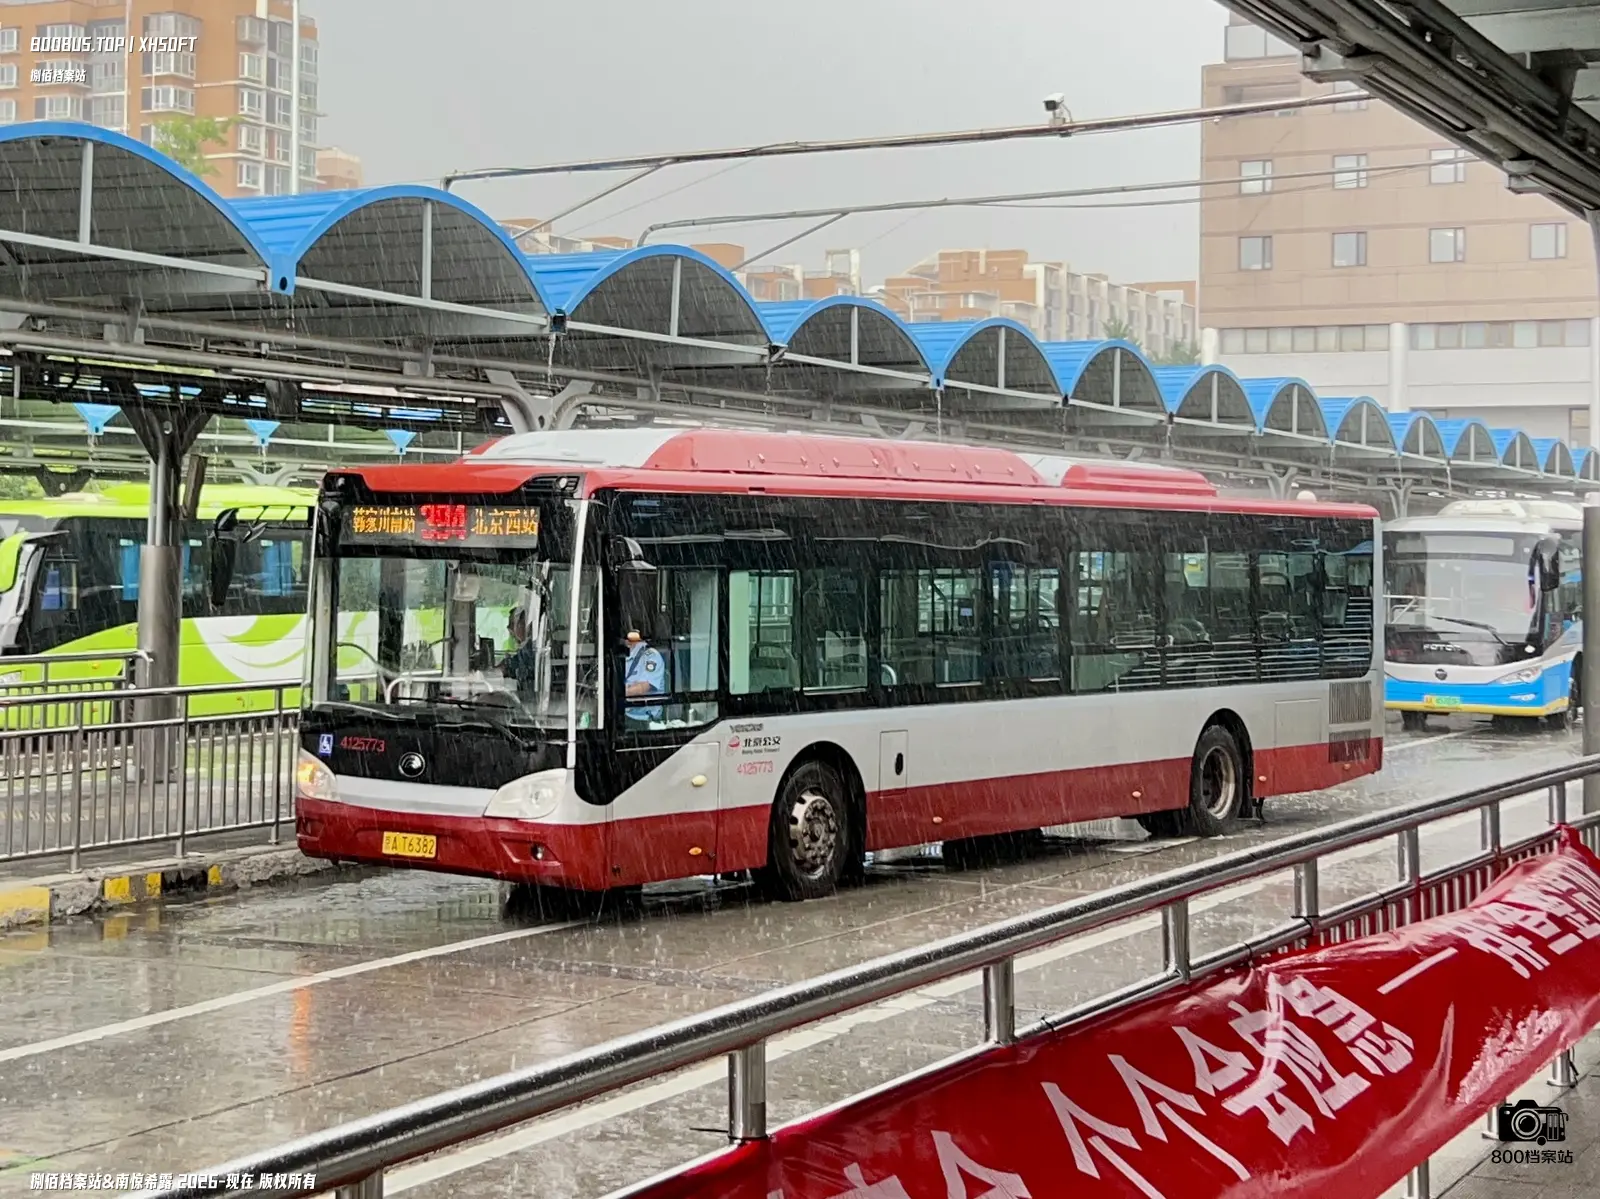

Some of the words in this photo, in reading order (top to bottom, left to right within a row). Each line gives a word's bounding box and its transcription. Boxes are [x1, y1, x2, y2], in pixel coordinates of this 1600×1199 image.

[470, 508, 539, 536] 北京西站
[340, 736, 385, 752] 4125773
[742, 736, 781, 747] 北京公交
[737, 760, 774, 775] 4125773
